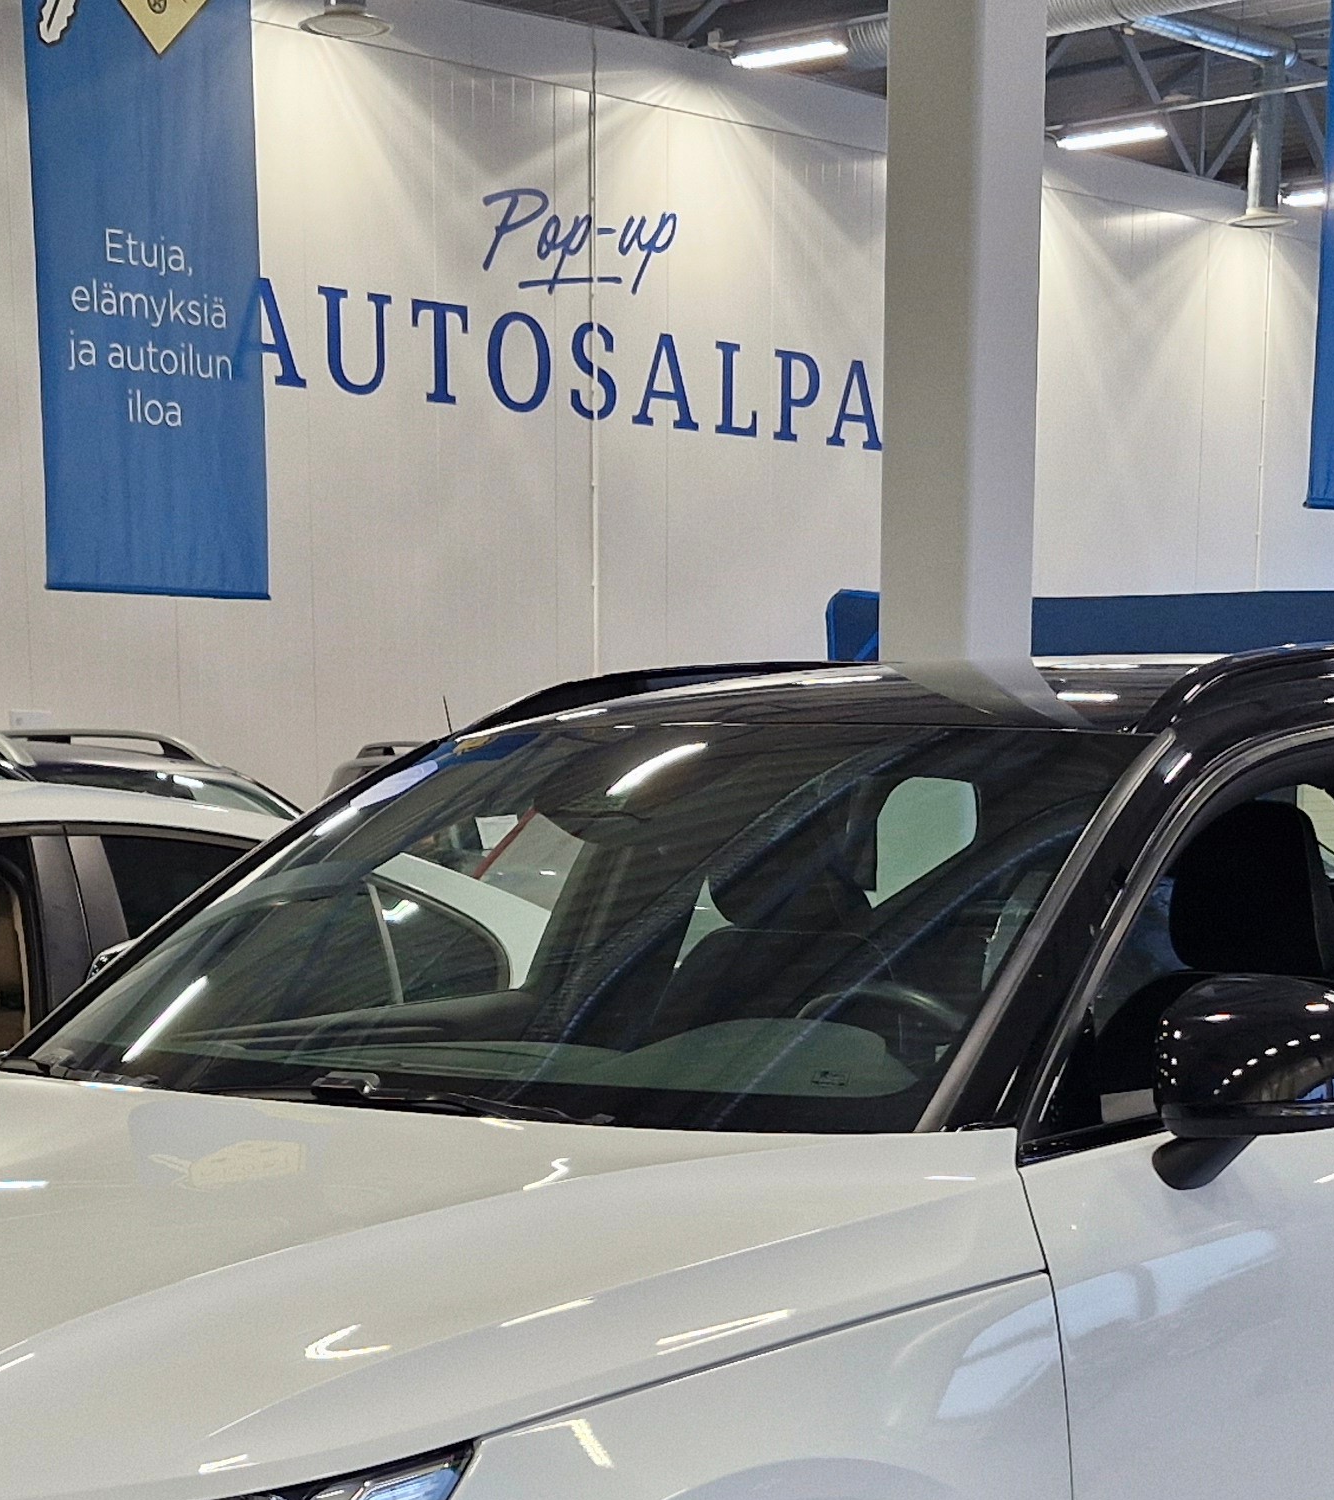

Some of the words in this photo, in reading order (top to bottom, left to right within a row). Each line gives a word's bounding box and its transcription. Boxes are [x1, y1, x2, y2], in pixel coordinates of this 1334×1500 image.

[104, 227, 193, 277] Etuja,
[482, 187, 677, 295] Pop-up
[71, 277, 228, 329] elämyksiä
[68, 329, 97, 371] ja
[107, 340, 233, 381] autoilun
[127, 387, 183, 427] iloa
